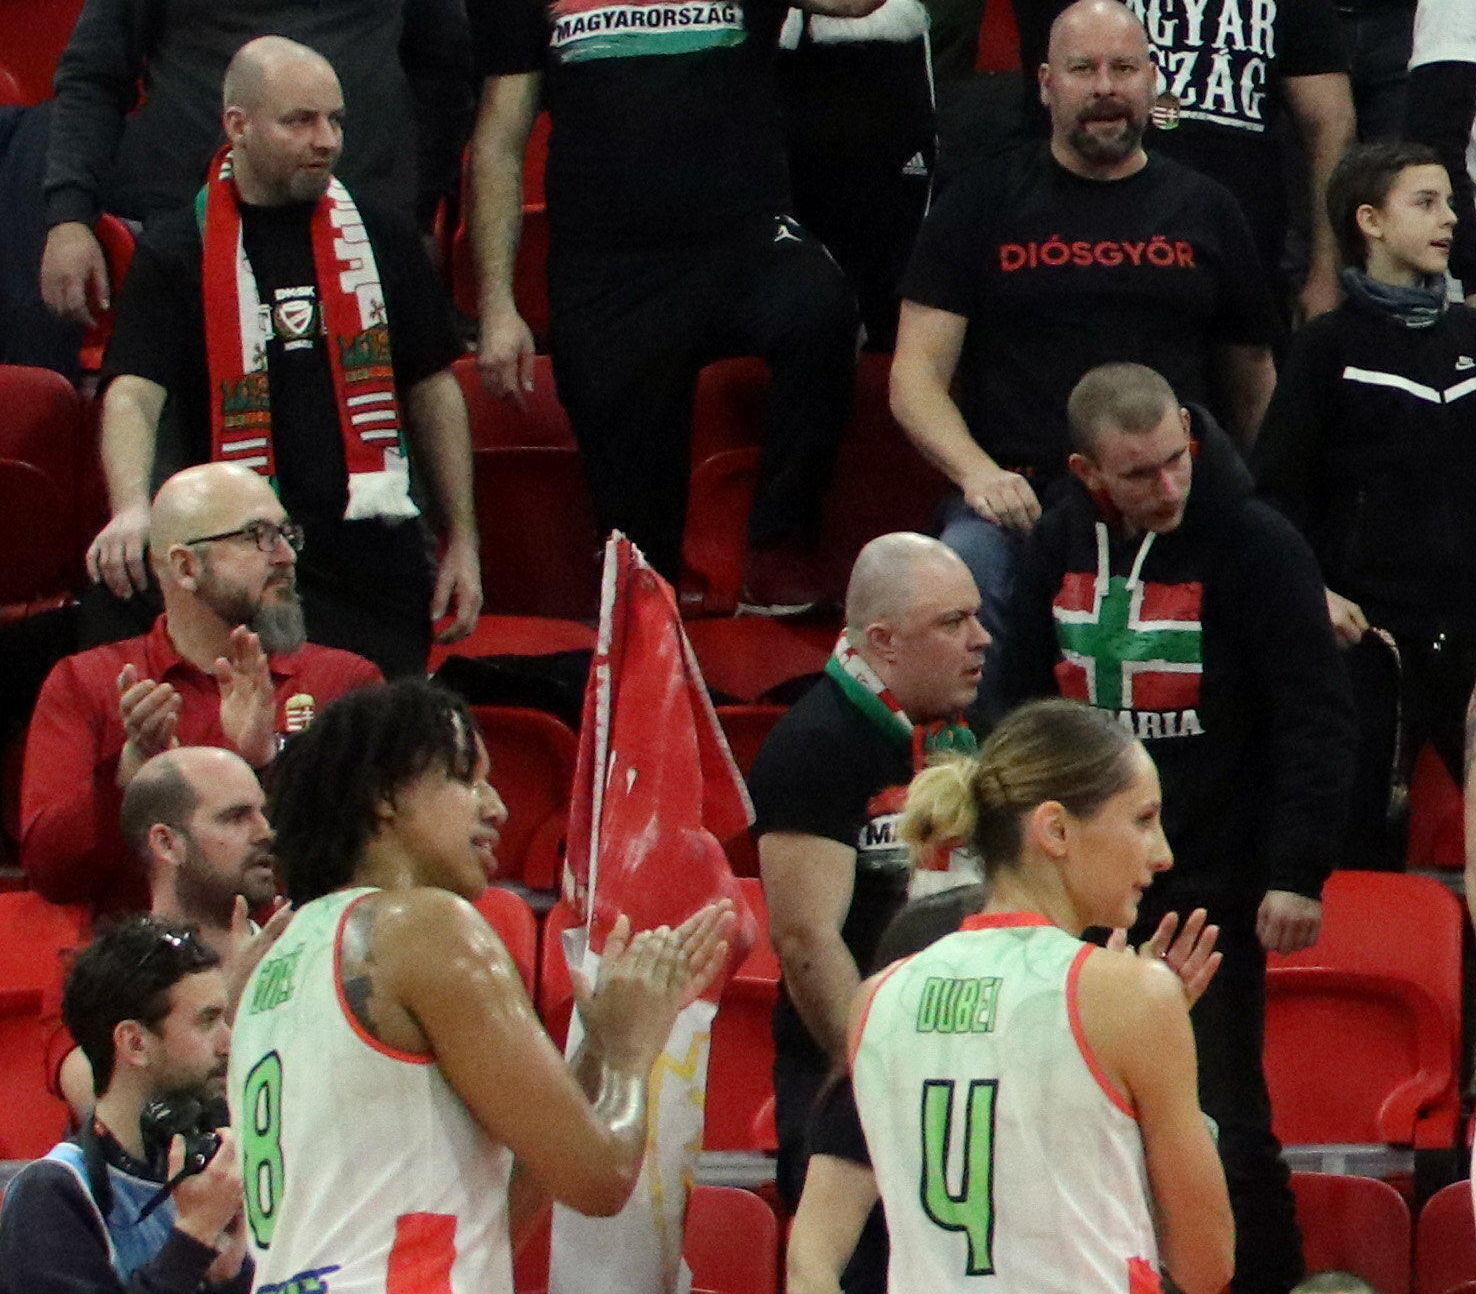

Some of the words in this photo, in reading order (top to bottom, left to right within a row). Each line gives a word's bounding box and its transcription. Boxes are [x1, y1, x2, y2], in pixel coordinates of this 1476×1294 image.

[552, 1, 738, 46] MAGYARORSZÁG
[1153, 44, 1267, 120] SZÁG
[999, 236, 1196, 272] DIÓSGYŐR
[245, 1050, 284, 1250] 8
[920, 1079, 999, 1276] 4
